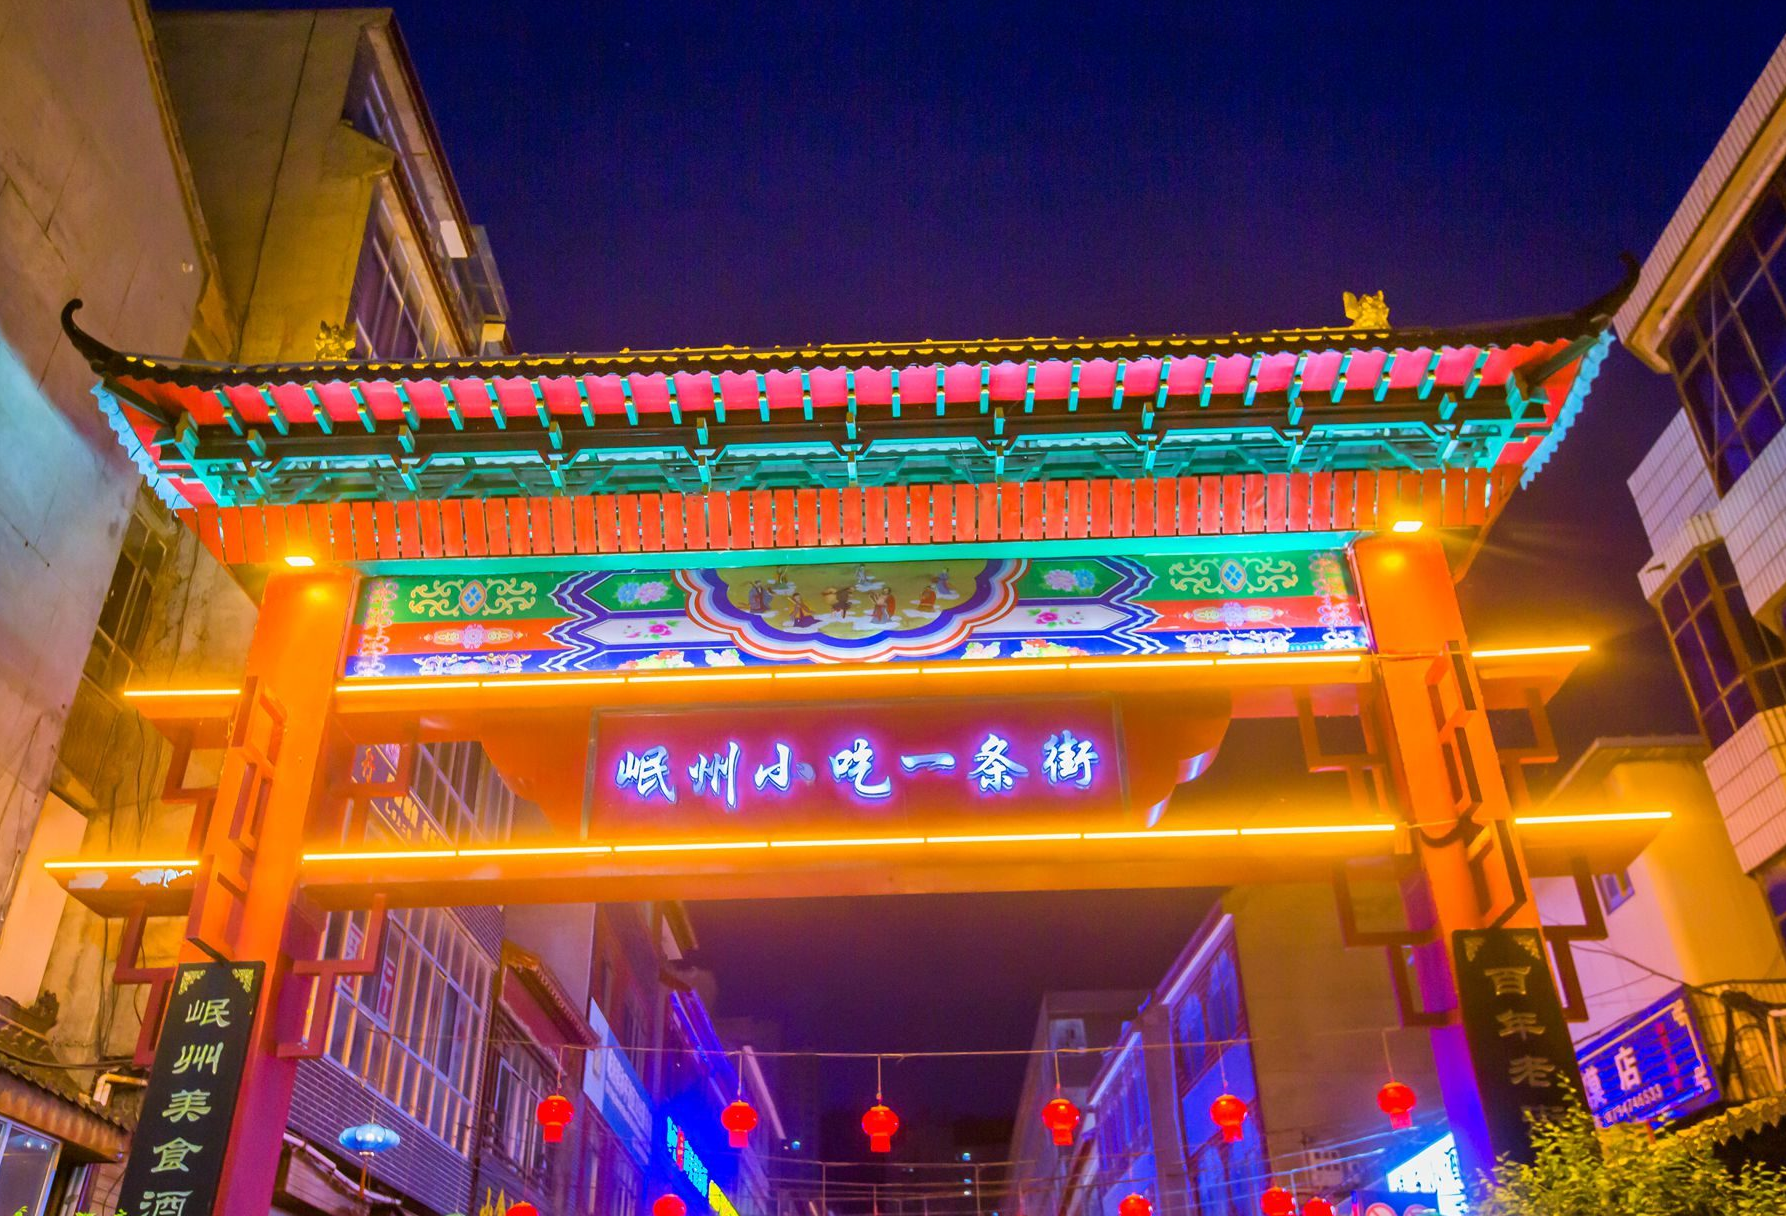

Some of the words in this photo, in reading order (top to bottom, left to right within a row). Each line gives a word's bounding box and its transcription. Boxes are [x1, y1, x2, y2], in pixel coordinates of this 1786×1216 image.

[615, 729, 1100, 809] 岷州小吃一条街
